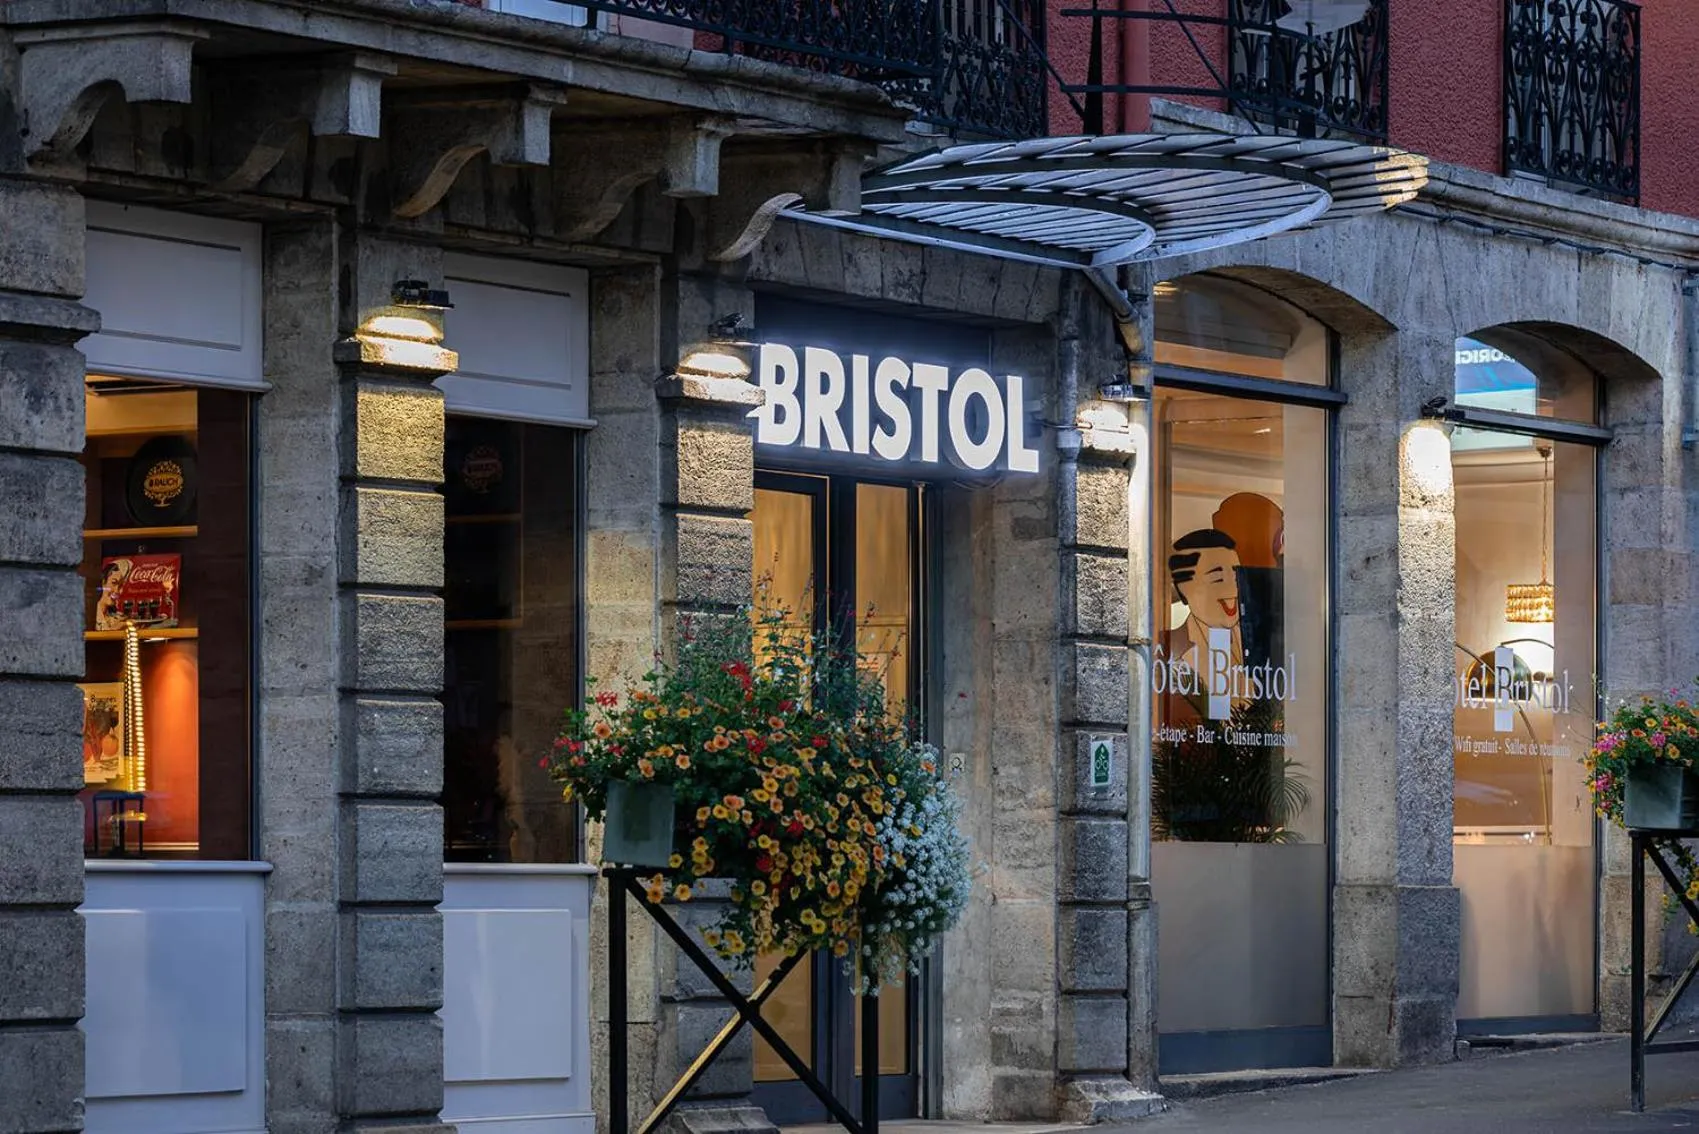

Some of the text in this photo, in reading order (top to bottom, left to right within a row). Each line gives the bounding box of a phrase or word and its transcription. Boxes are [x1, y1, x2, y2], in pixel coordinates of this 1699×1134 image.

[757, 342, 1040, 473] BRISTOL
[1210, 647, 1298, 701] Bristol
[1196, 724, 1215, 744] Bar
[1224, 725, 1262, 746] Cuisine
